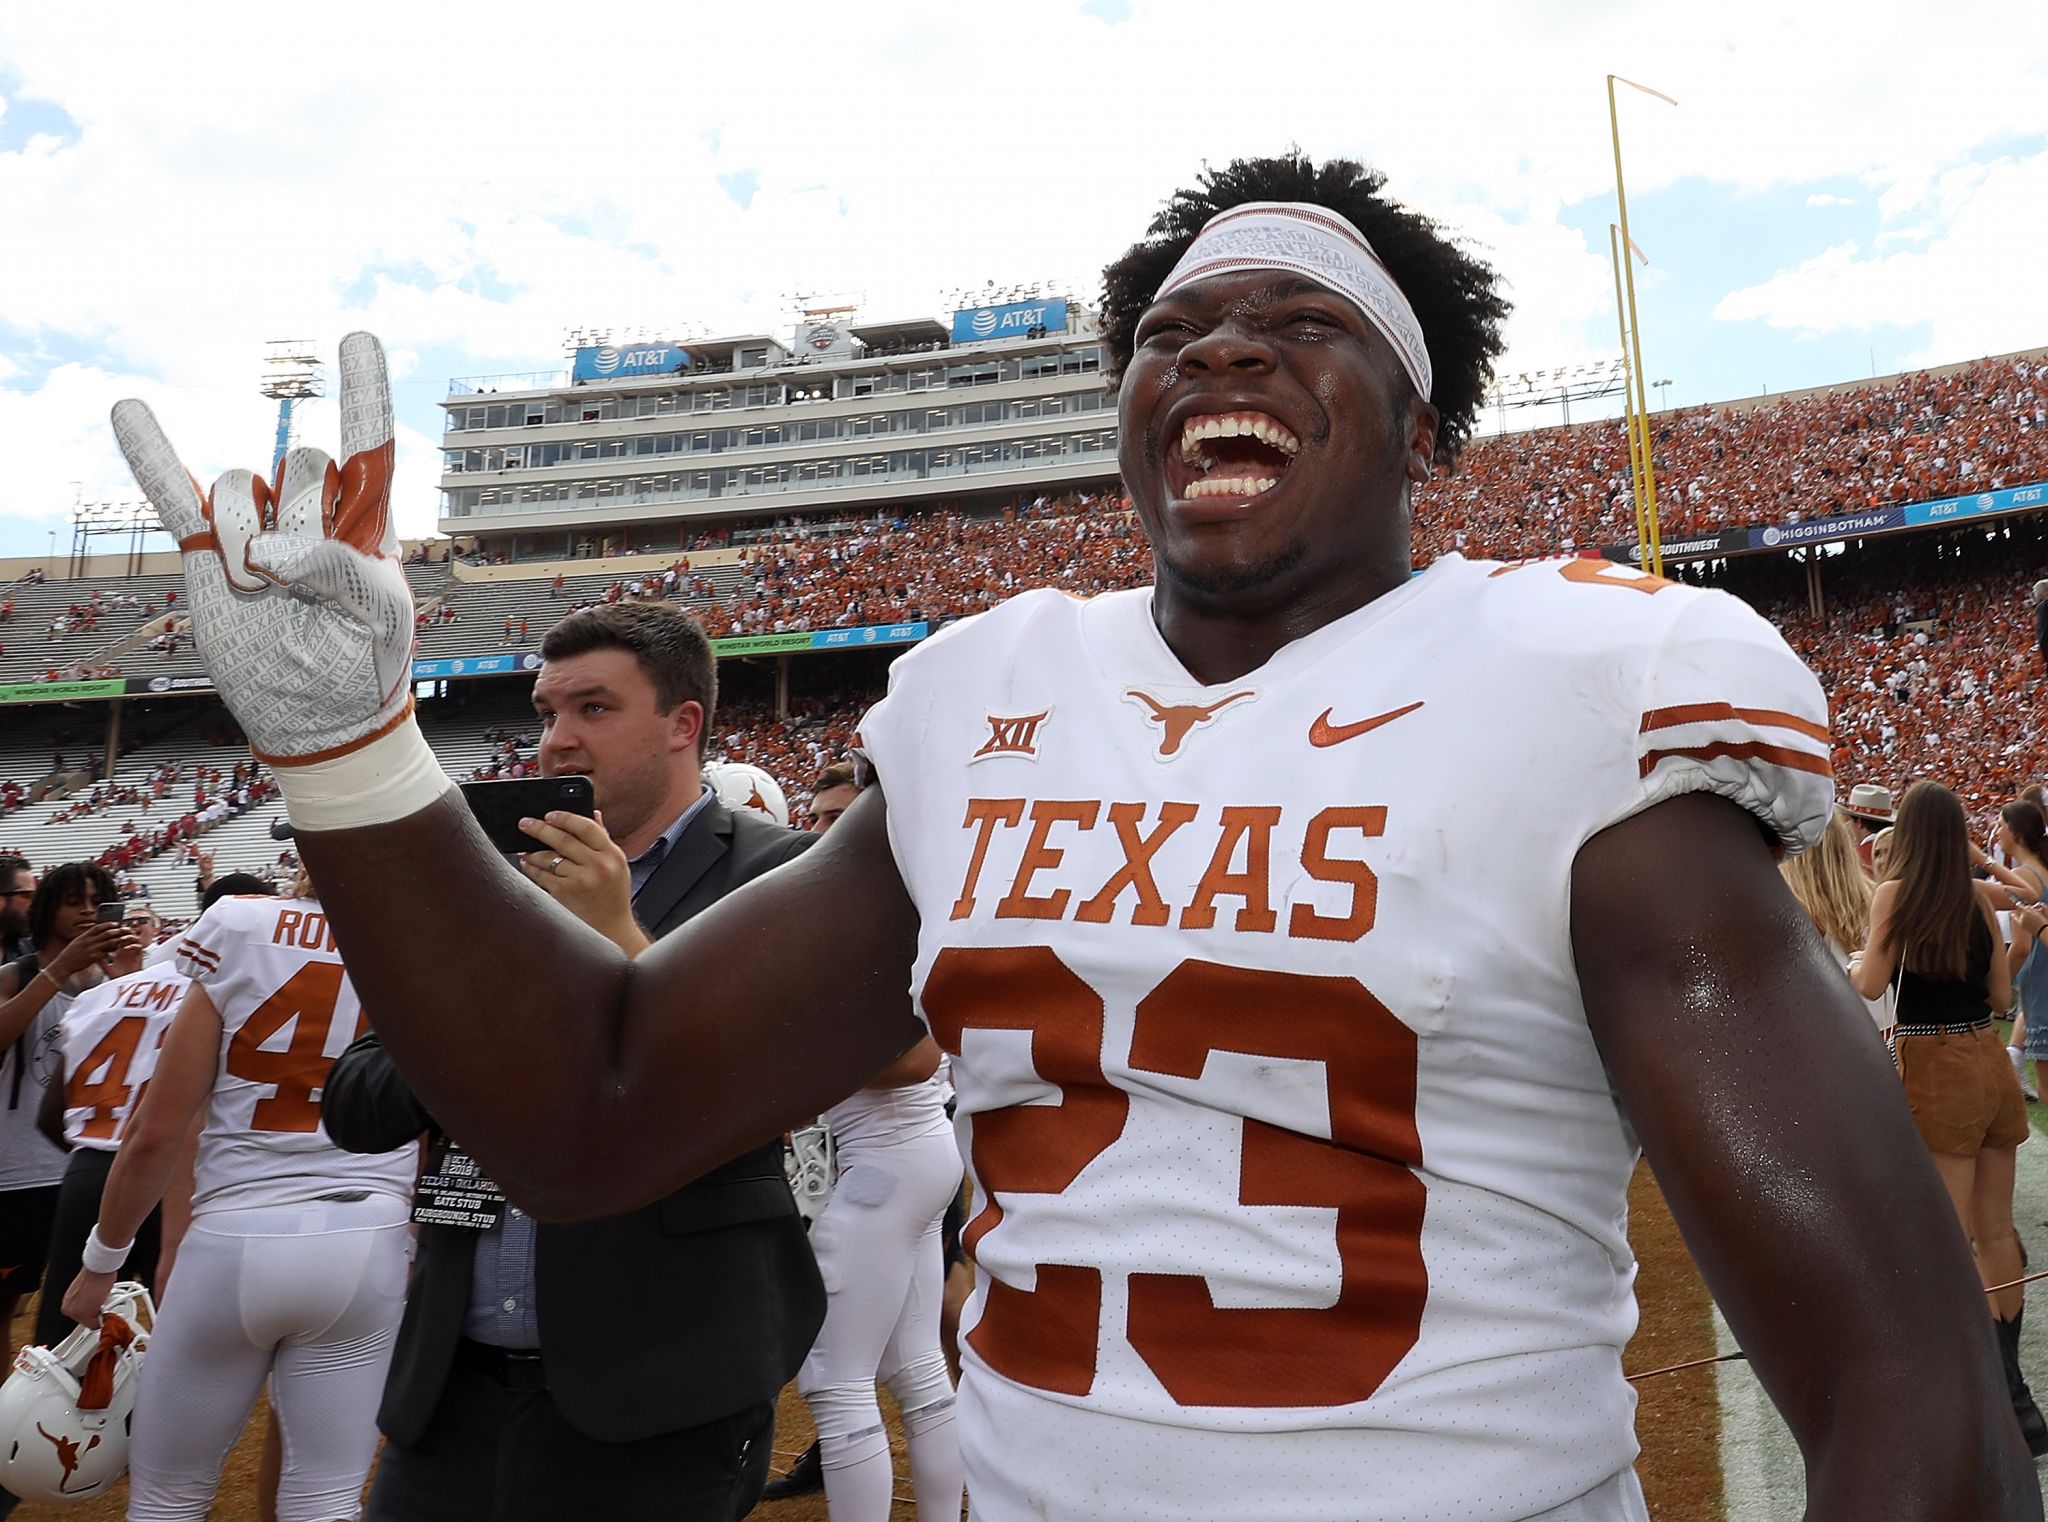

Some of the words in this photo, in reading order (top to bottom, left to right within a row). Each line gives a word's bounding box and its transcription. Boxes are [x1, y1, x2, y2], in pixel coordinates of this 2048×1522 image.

[1000, 307, 1046, 328] AT&T
[623, 349, 669, 368] AT&T
[2012, 488, 2042, 503] AT&T
[1929, 502, 1959, 517] AT&T
[1780, 516, 1885, 540] HIGGINBOTHAM
[1659, 538, 1720, 556] SOUTHWEST
[235, 606, 286, 641] TEXAS
[246, 620, 287, 656] FIGHT
[717, 641, 751, 650] WINSTAR
[753, 639, 779, 648] WORLD
[781, 636, 811, 646] RESORT
[826, 632, 851, 643] AT&T
[889, 627, 914, 638] AT&T
[974, 712, 1047, 758] XII
[949, 798, 1388, 943] TEXAS
[226, 960, 369, 1132] 4
[448, 1164, 473, 1176] 2018
[920, 945, 1428, 1406] 23
[421, 1175, 451, 1188] TEXAS
[434, 1196, 457, 1206] GATE
[456, 1199, 482, 1210] STUB
[414, 1208, 470, 1221] FAIRGROUNDS
[471, 1213, 497, 1224] STUB
